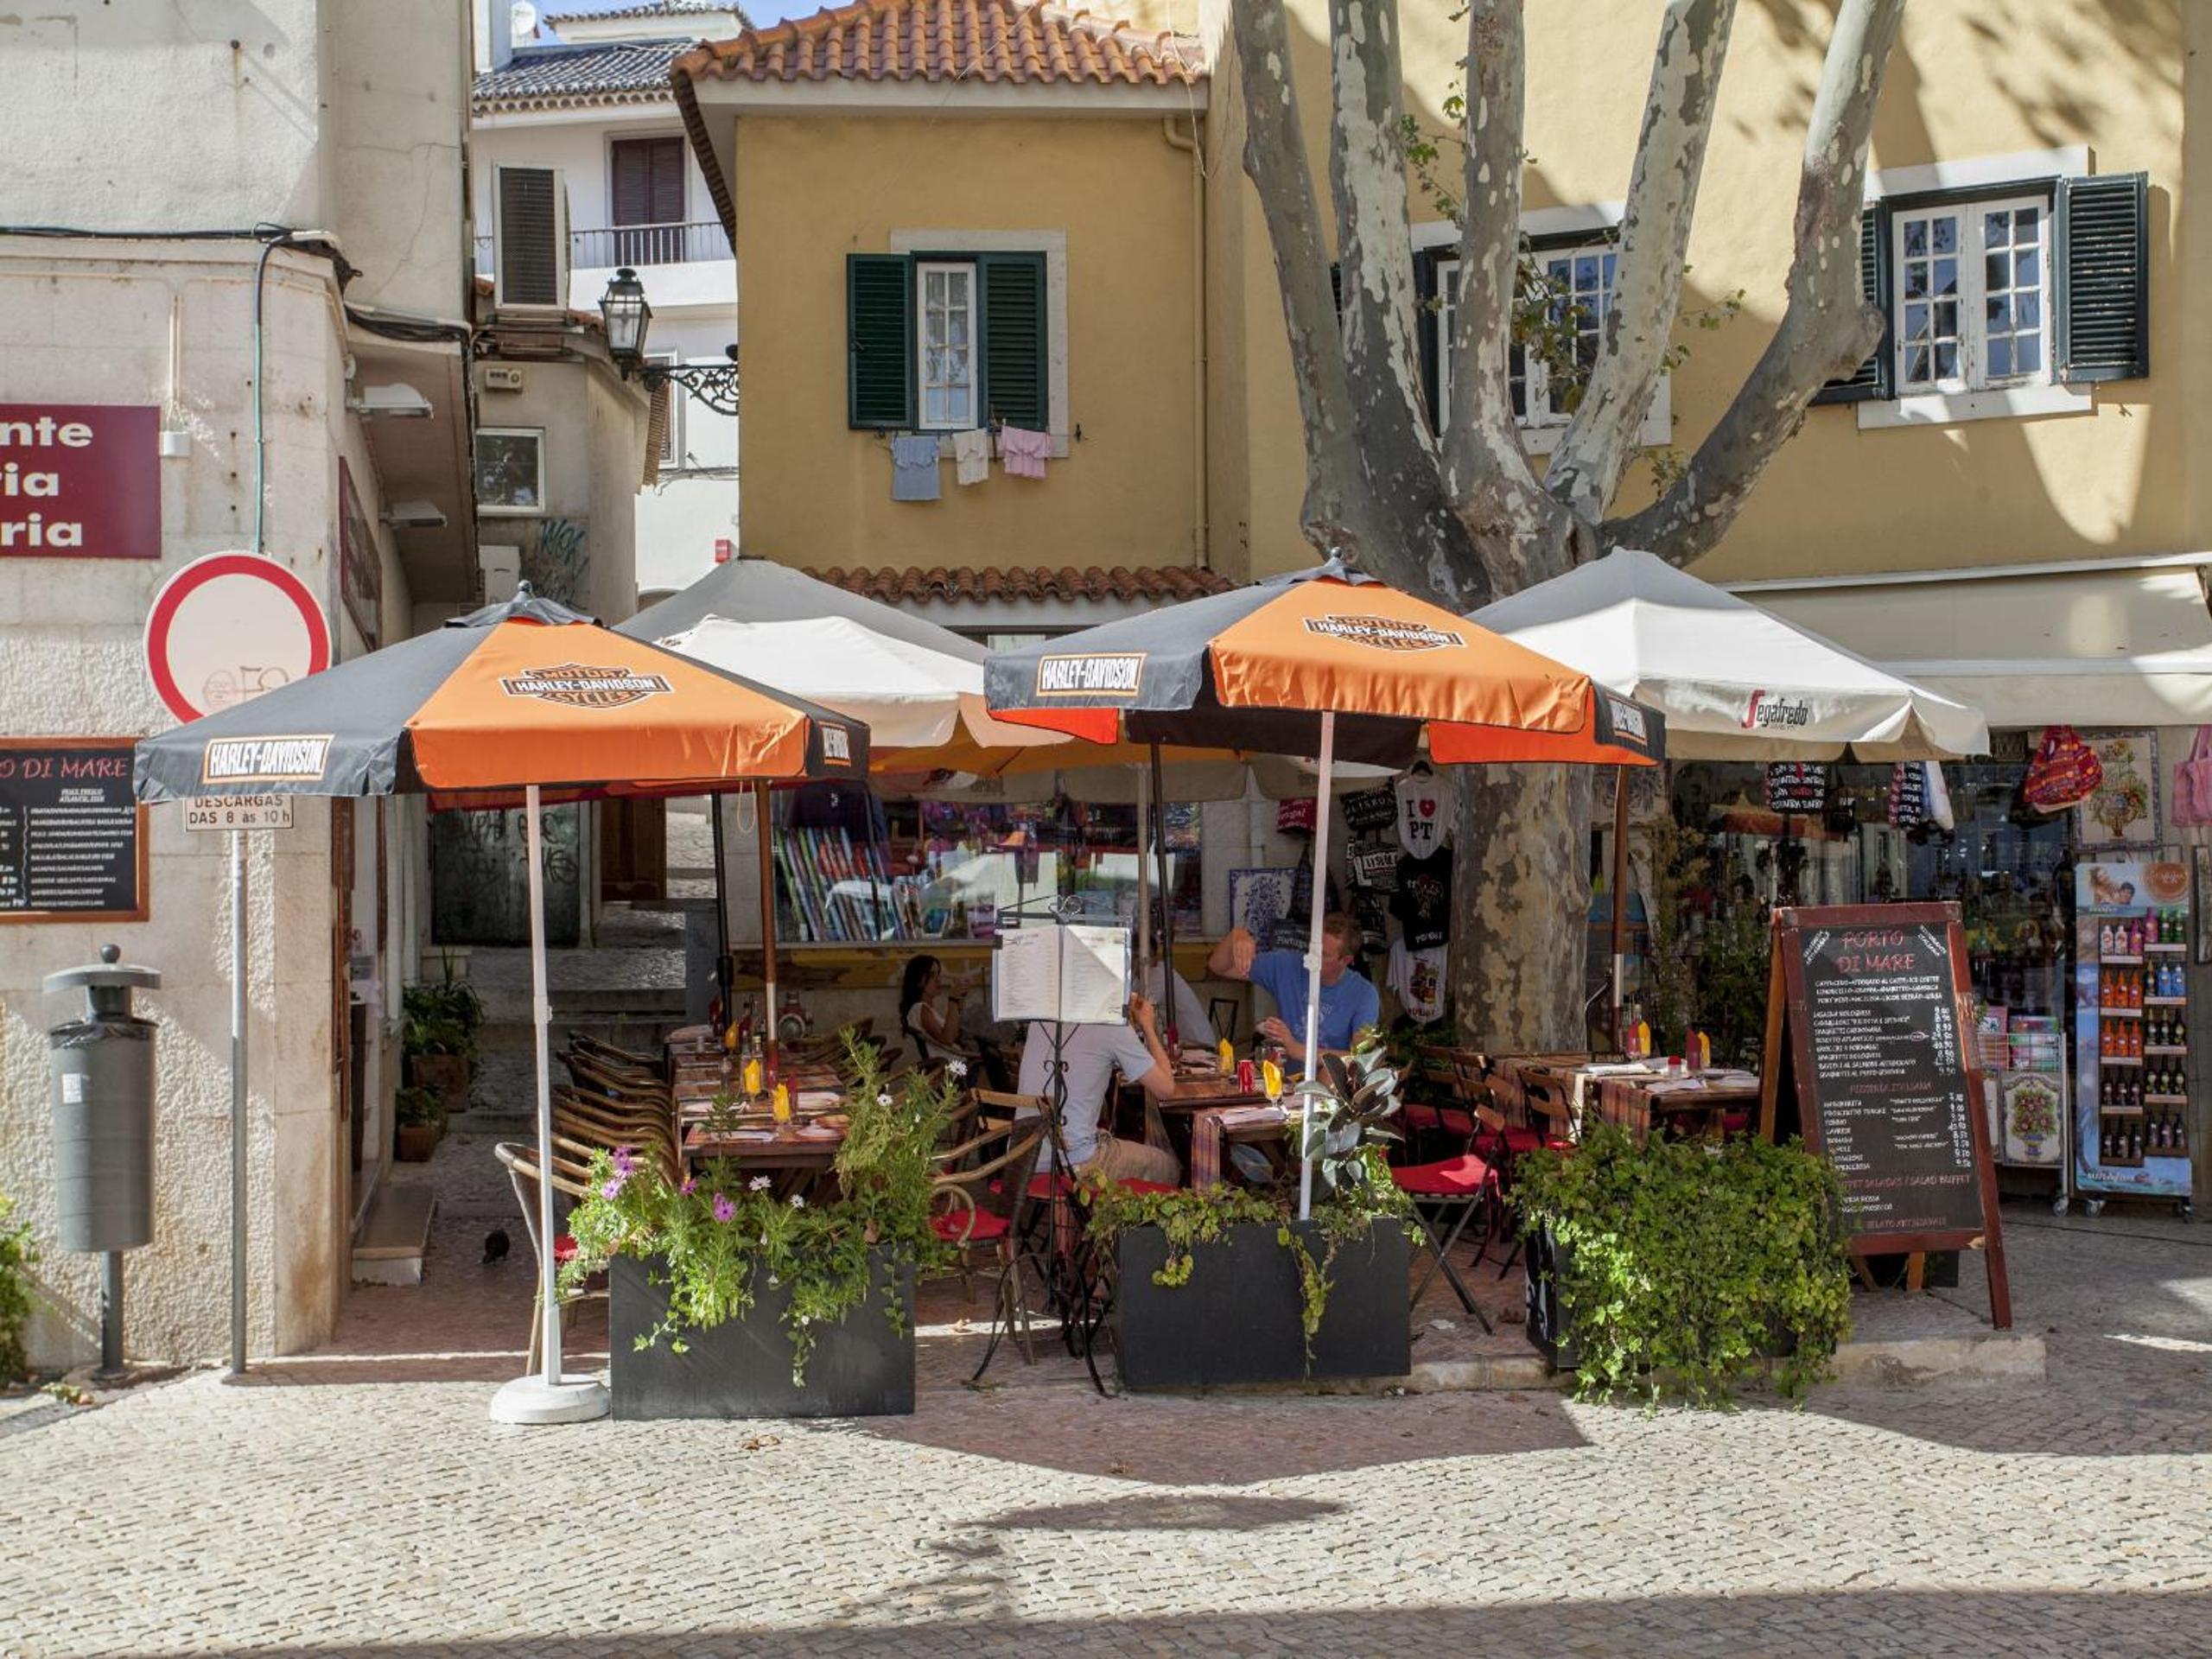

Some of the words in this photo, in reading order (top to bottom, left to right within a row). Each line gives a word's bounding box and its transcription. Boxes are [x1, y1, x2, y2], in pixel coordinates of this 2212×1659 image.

[517, 678, 657, 691] HARLEY-DAVIDSON
[1741, 690, 1808, 728] Segafredo
[60, 756, 129, 778] MARE
[210, 740, 326, 777] HARLEY-DAVIDSON
[189, 812, 217, 823] DAS
[226, 811, 234, 823] 8
[264, 810, 278, 823] 10
[283, 810, 290, 822] h
[1410, 823, 1433, 840] PT
[1841, 930, 1904, 950] PORTO
[1866, 953, 1916, 973] MARE
